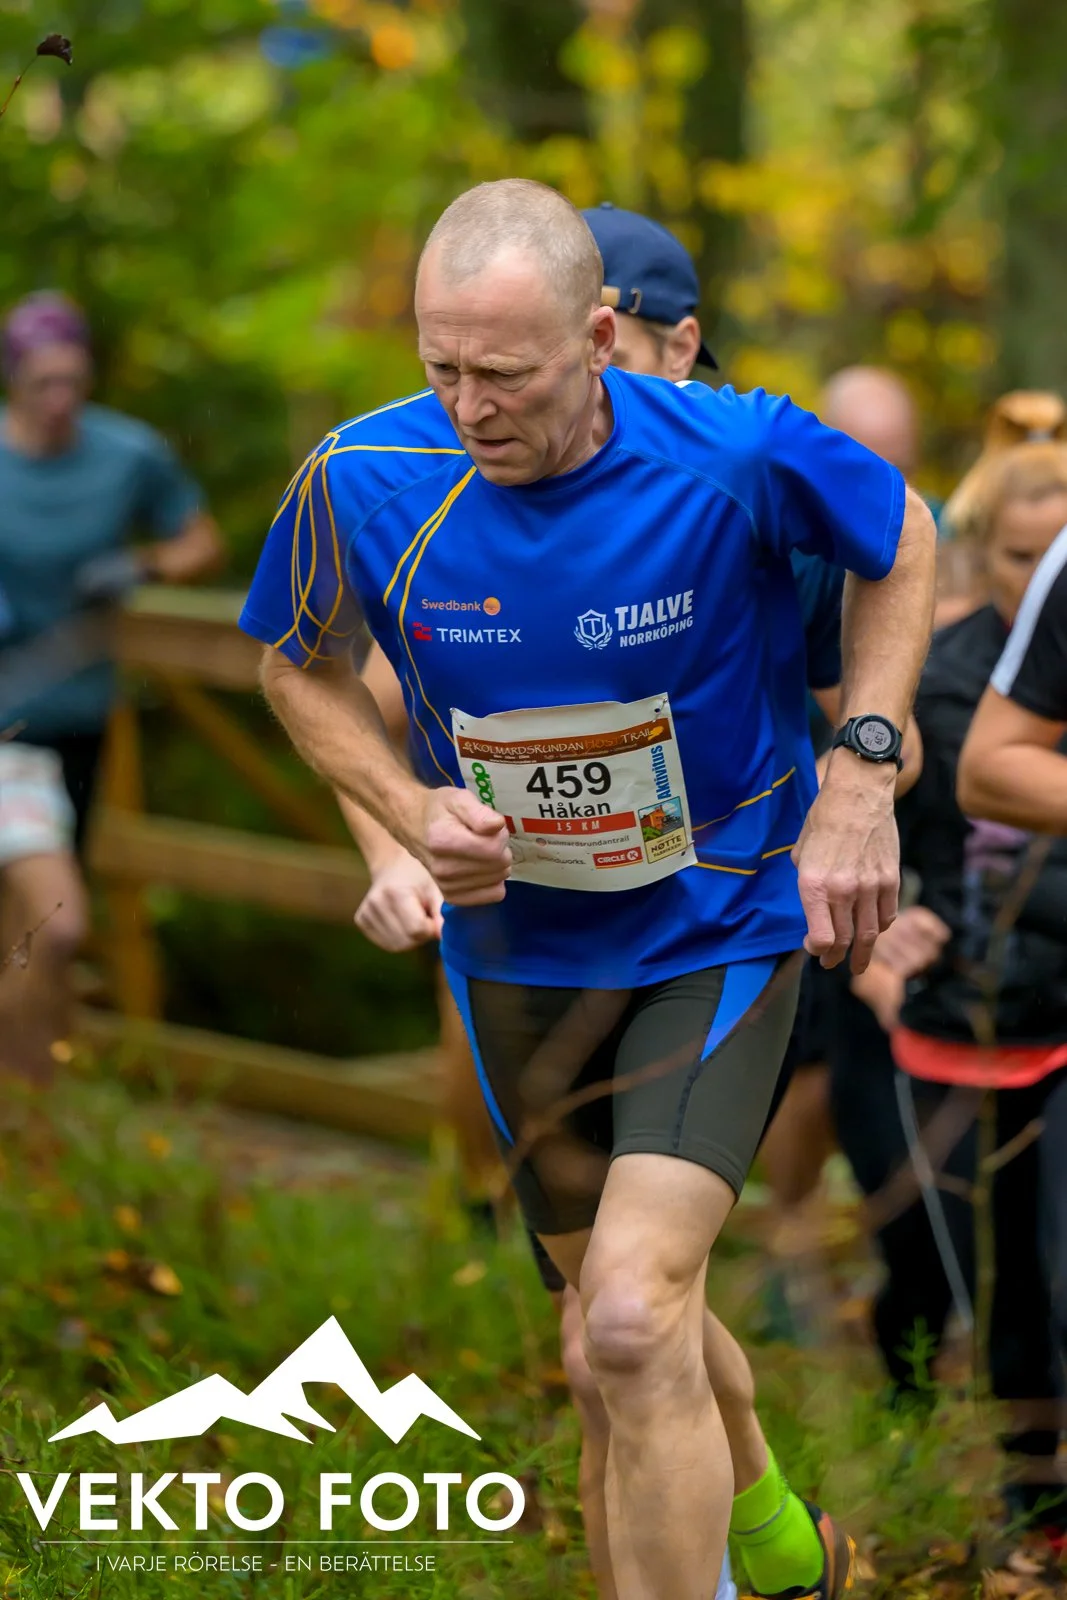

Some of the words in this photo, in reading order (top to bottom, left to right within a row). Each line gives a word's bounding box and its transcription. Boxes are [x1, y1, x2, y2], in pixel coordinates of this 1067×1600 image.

[421, 598, 482, 613] Swedbank
[614, 588, 695, 632] TJALVE
[436, 627, 523, 644] TRIMTEX
[618, 615, 694, 648] NORRKÖPING
[526, 761, 612, 800] 459
[650, 744, 673, 800] Aktivitus
[538, 800, 612, 819] Håkan
[581, 820, 601, 831] KM
[650, 834, 682, 853] NØTTE
[596, 853, 626, 864] CIRCLE
